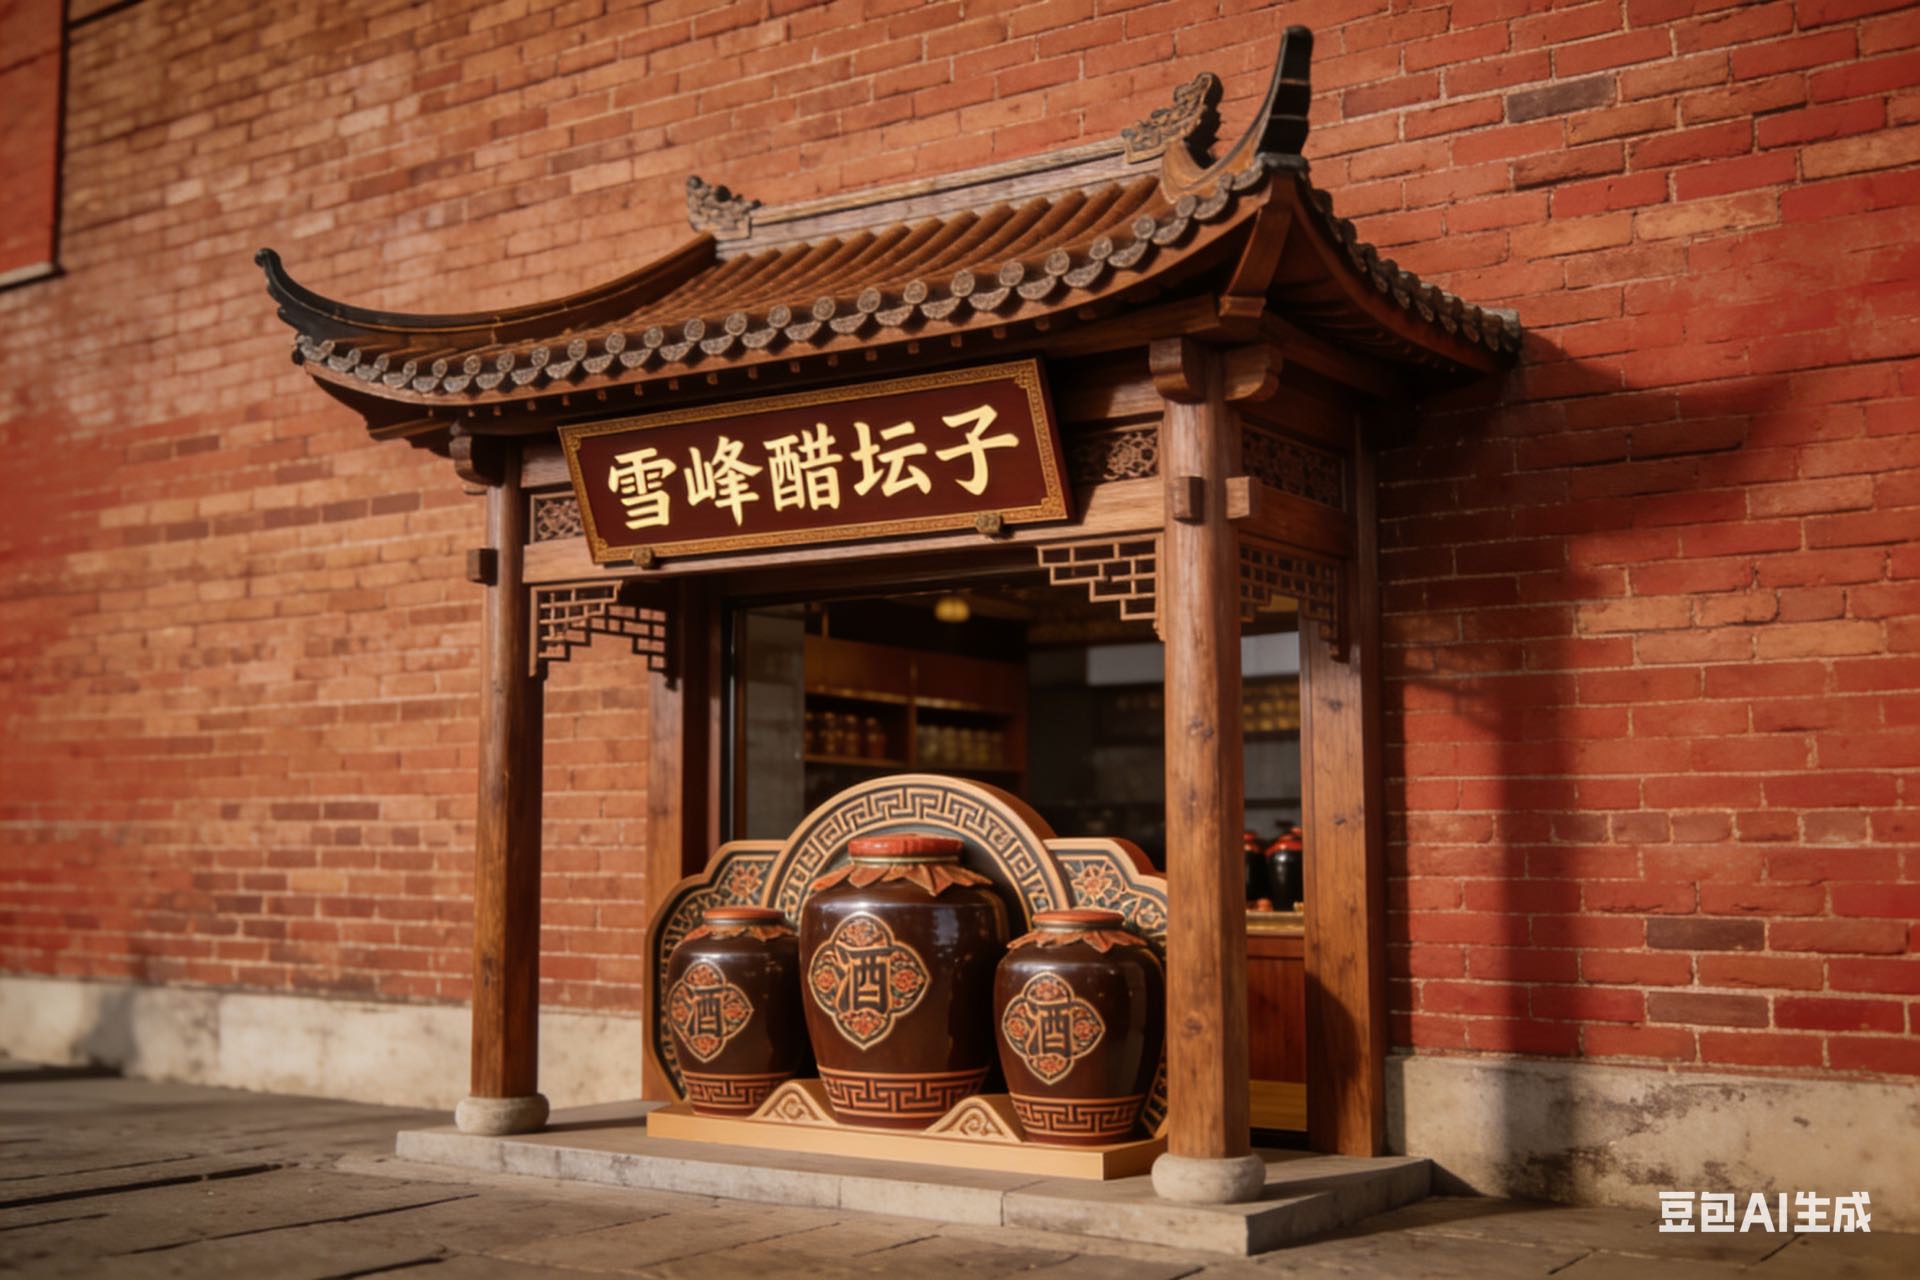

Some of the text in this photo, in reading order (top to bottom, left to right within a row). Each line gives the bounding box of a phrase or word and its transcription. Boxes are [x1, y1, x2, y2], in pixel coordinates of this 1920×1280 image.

[607, 404, 1020, 530] 雪峰醋坛子
[833, 945, 894, 1014] 酒
